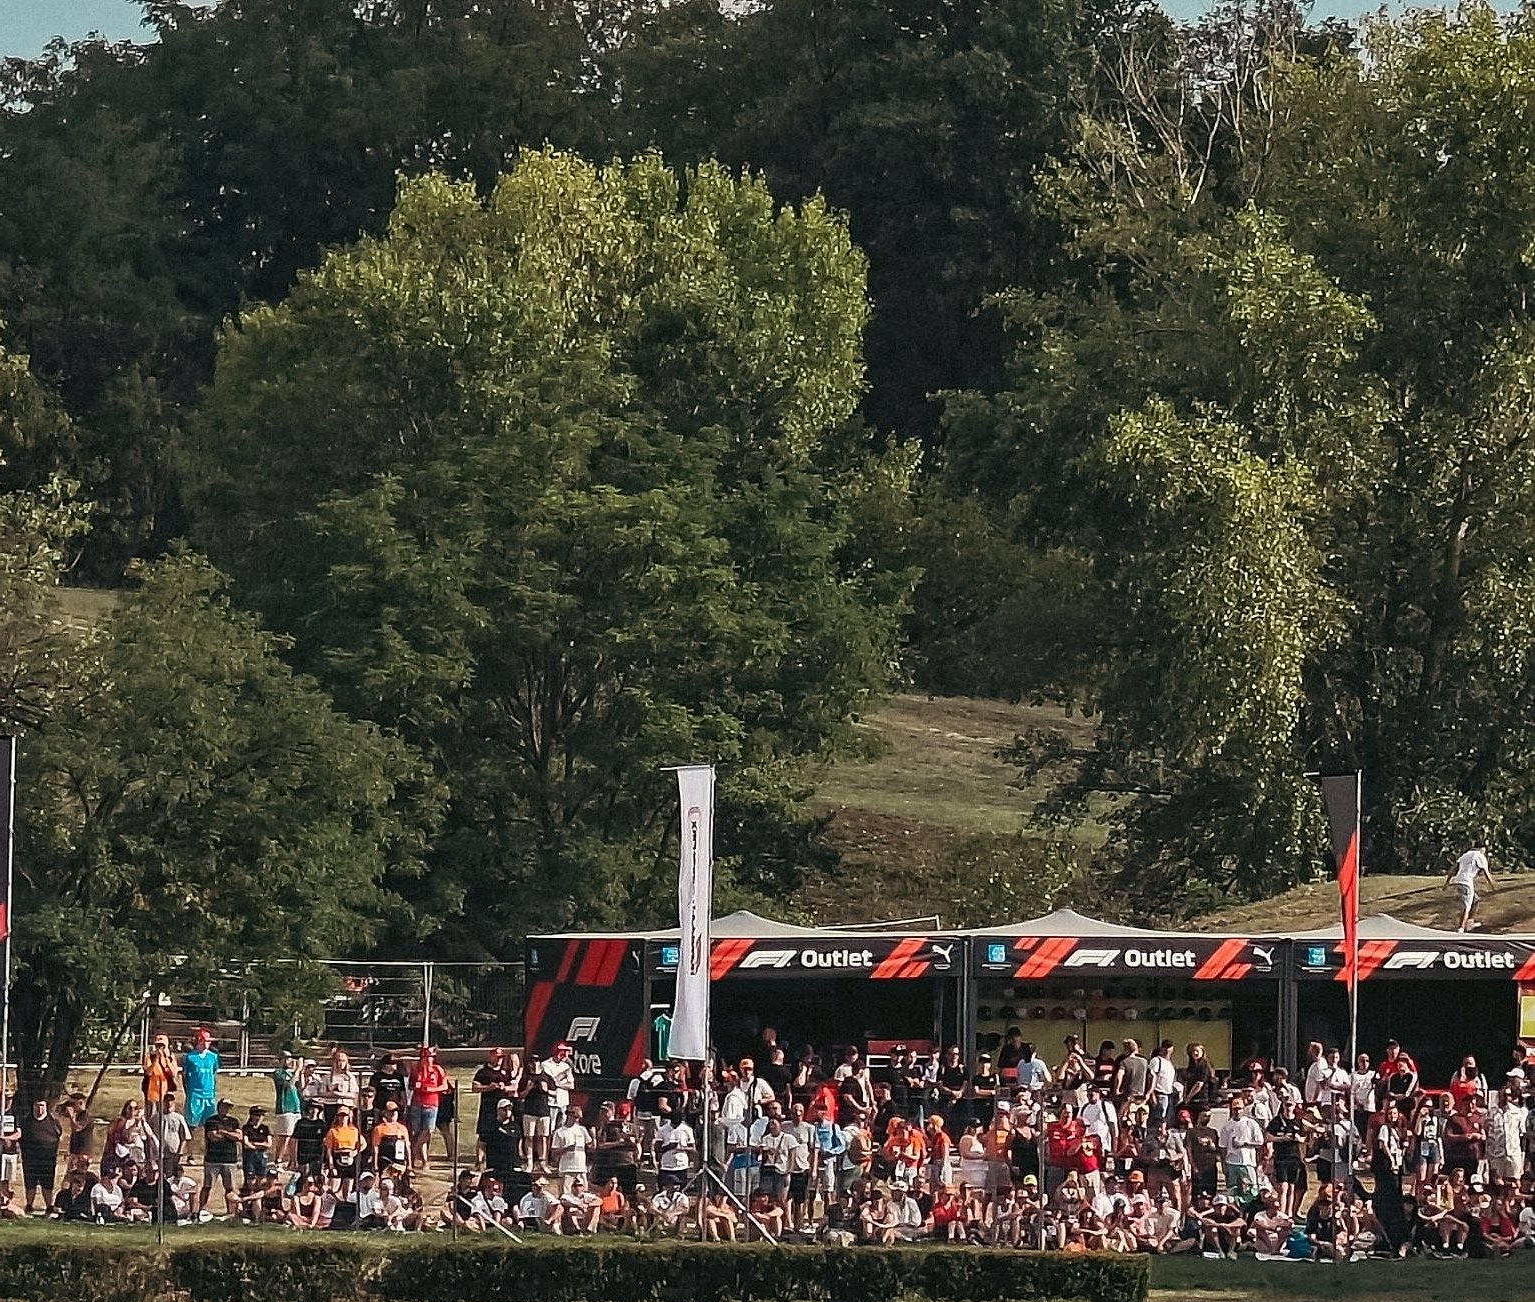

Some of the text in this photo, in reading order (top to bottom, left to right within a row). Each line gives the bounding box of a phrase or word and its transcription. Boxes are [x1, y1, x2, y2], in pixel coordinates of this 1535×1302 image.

[800, 948, 873, 968] Outlet
[1124, 949, 1196, 968] Outlet
[1443, 951, 1515, 969] Outlet
[573, 1049, 602, 1075] tore
